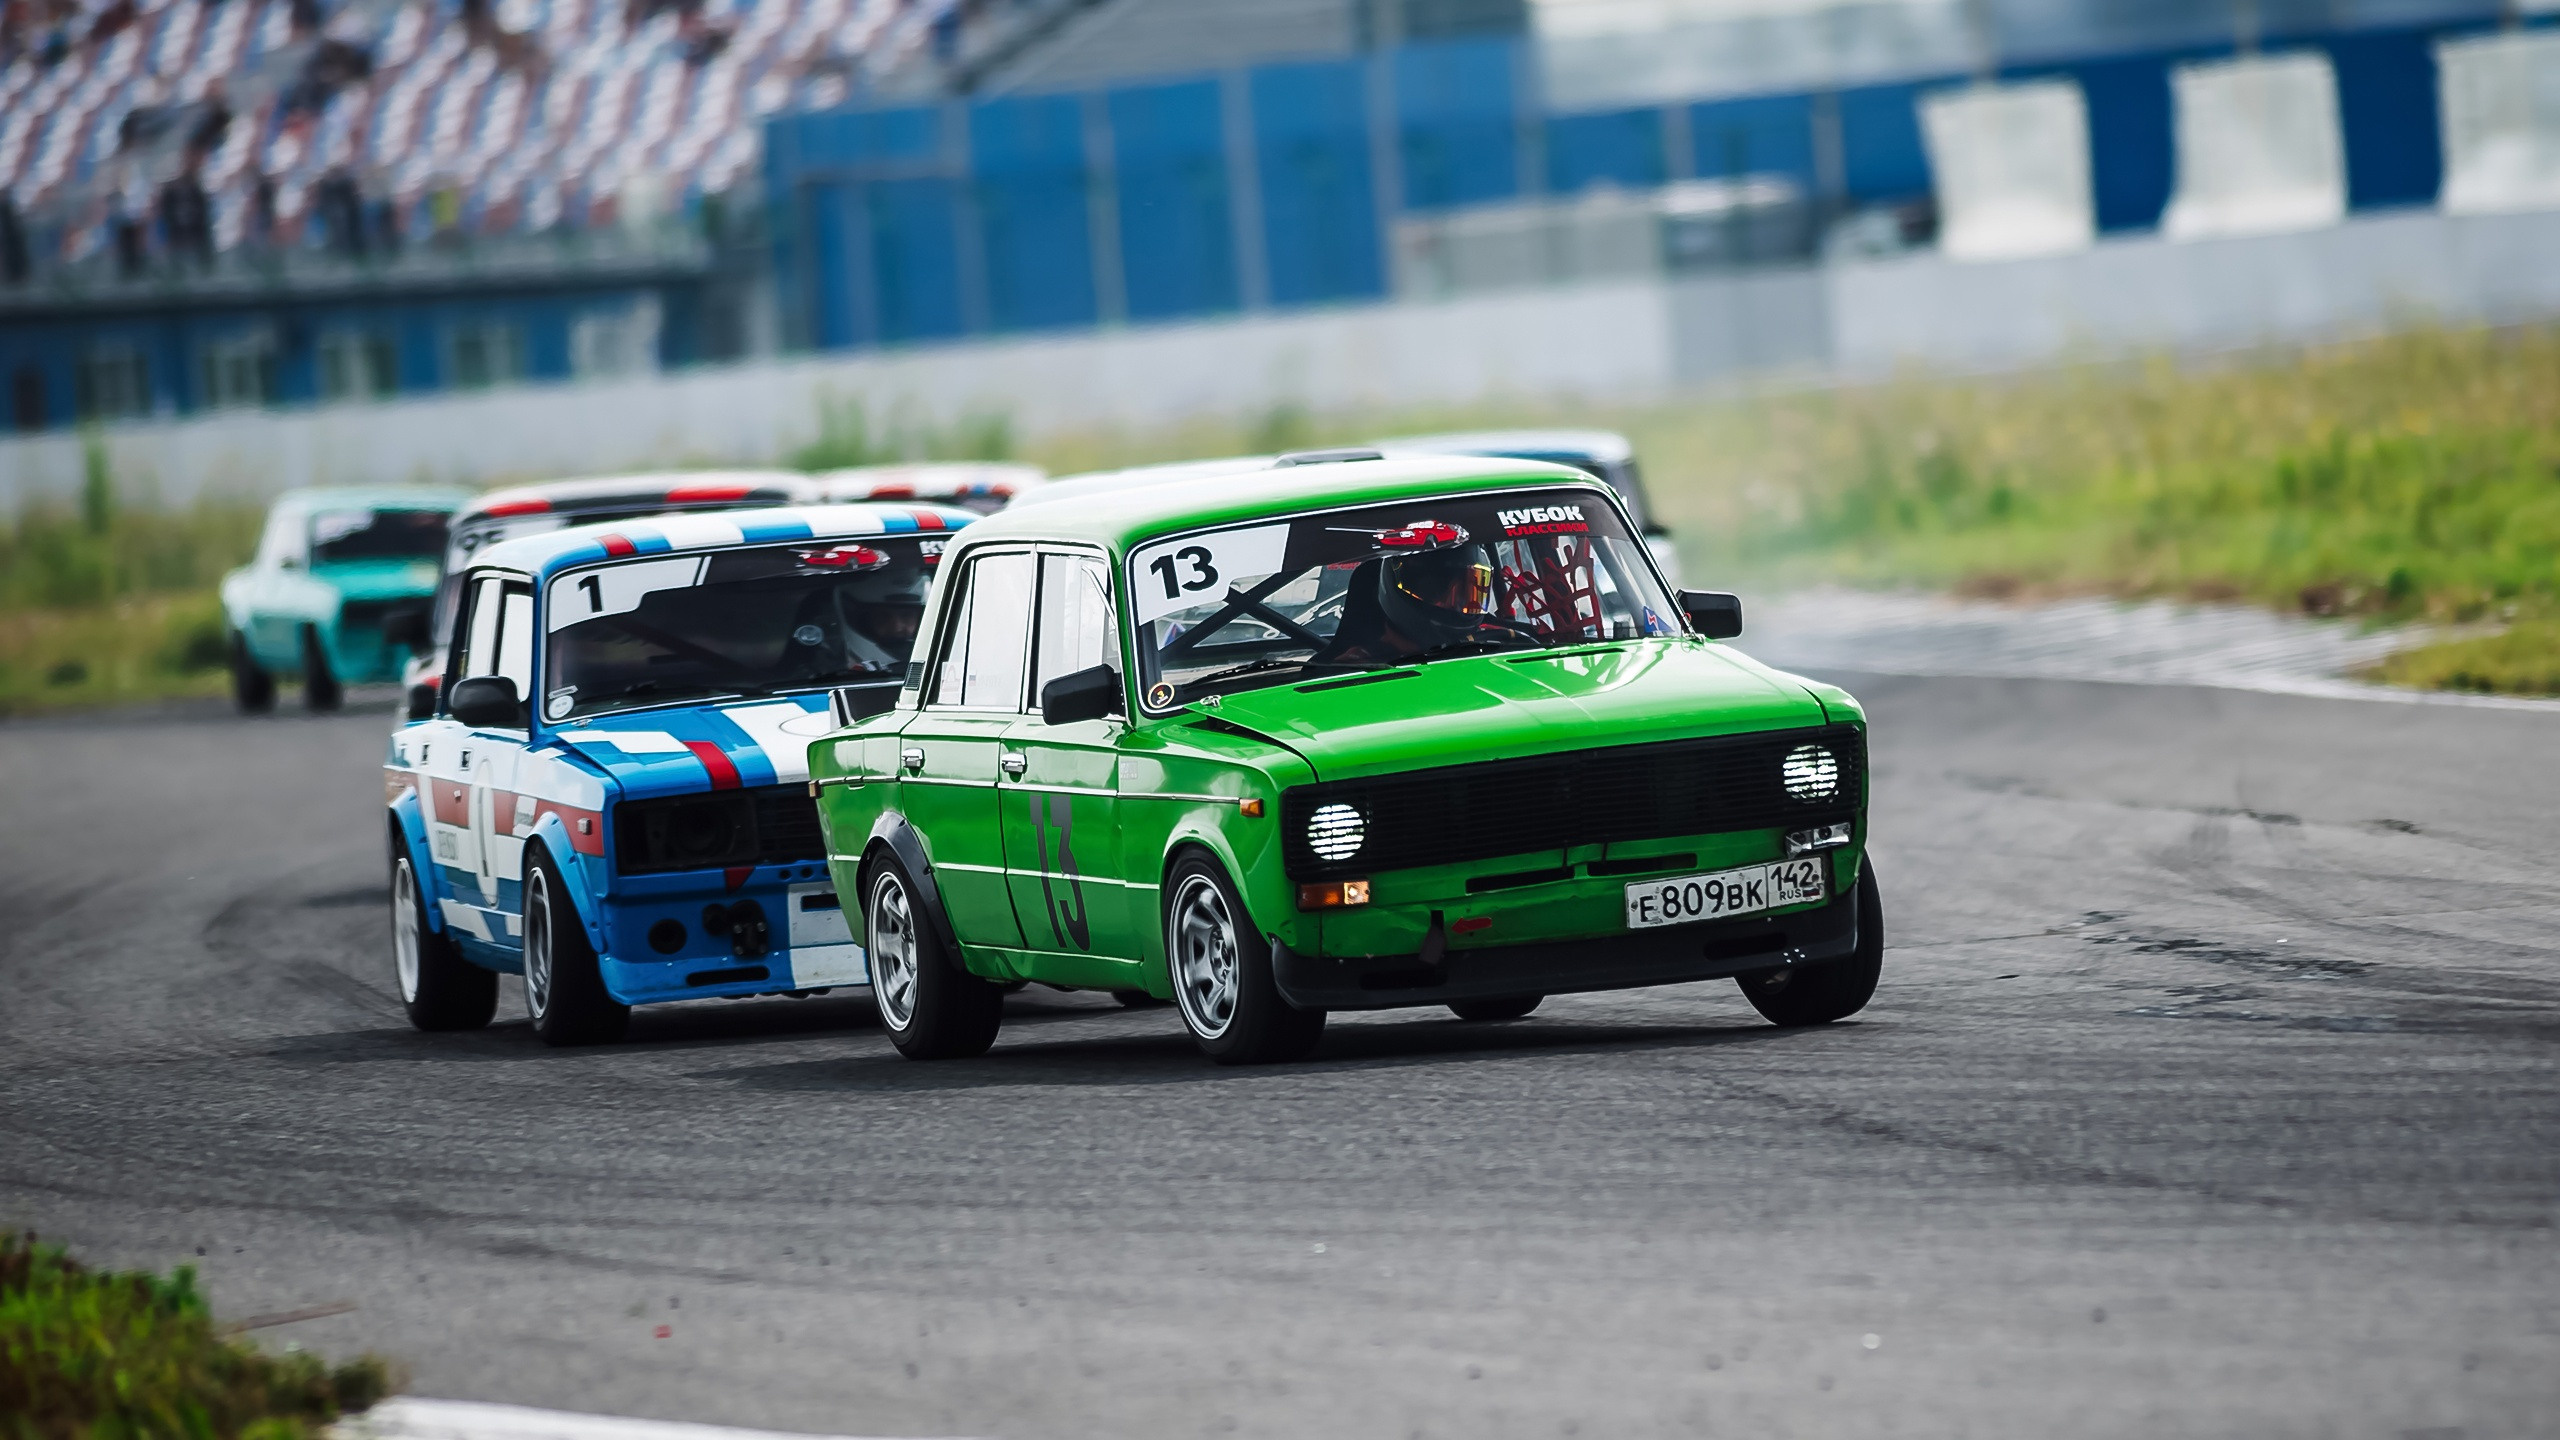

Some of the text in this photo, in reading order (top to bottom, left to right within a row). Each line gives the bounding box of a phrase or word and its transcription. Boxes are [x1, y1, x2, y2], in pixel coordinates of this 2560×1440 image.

[1497, 505, 1585, 526] КУБОК
[578, 574, 603, 613] 1
[1150, 546, 1219, 599] 13
[1029, 795, 1091, 951] 13
[1639, 861, 1815, 923] Е809ВК 142
[1779, 887, 1802, 901] RUS
